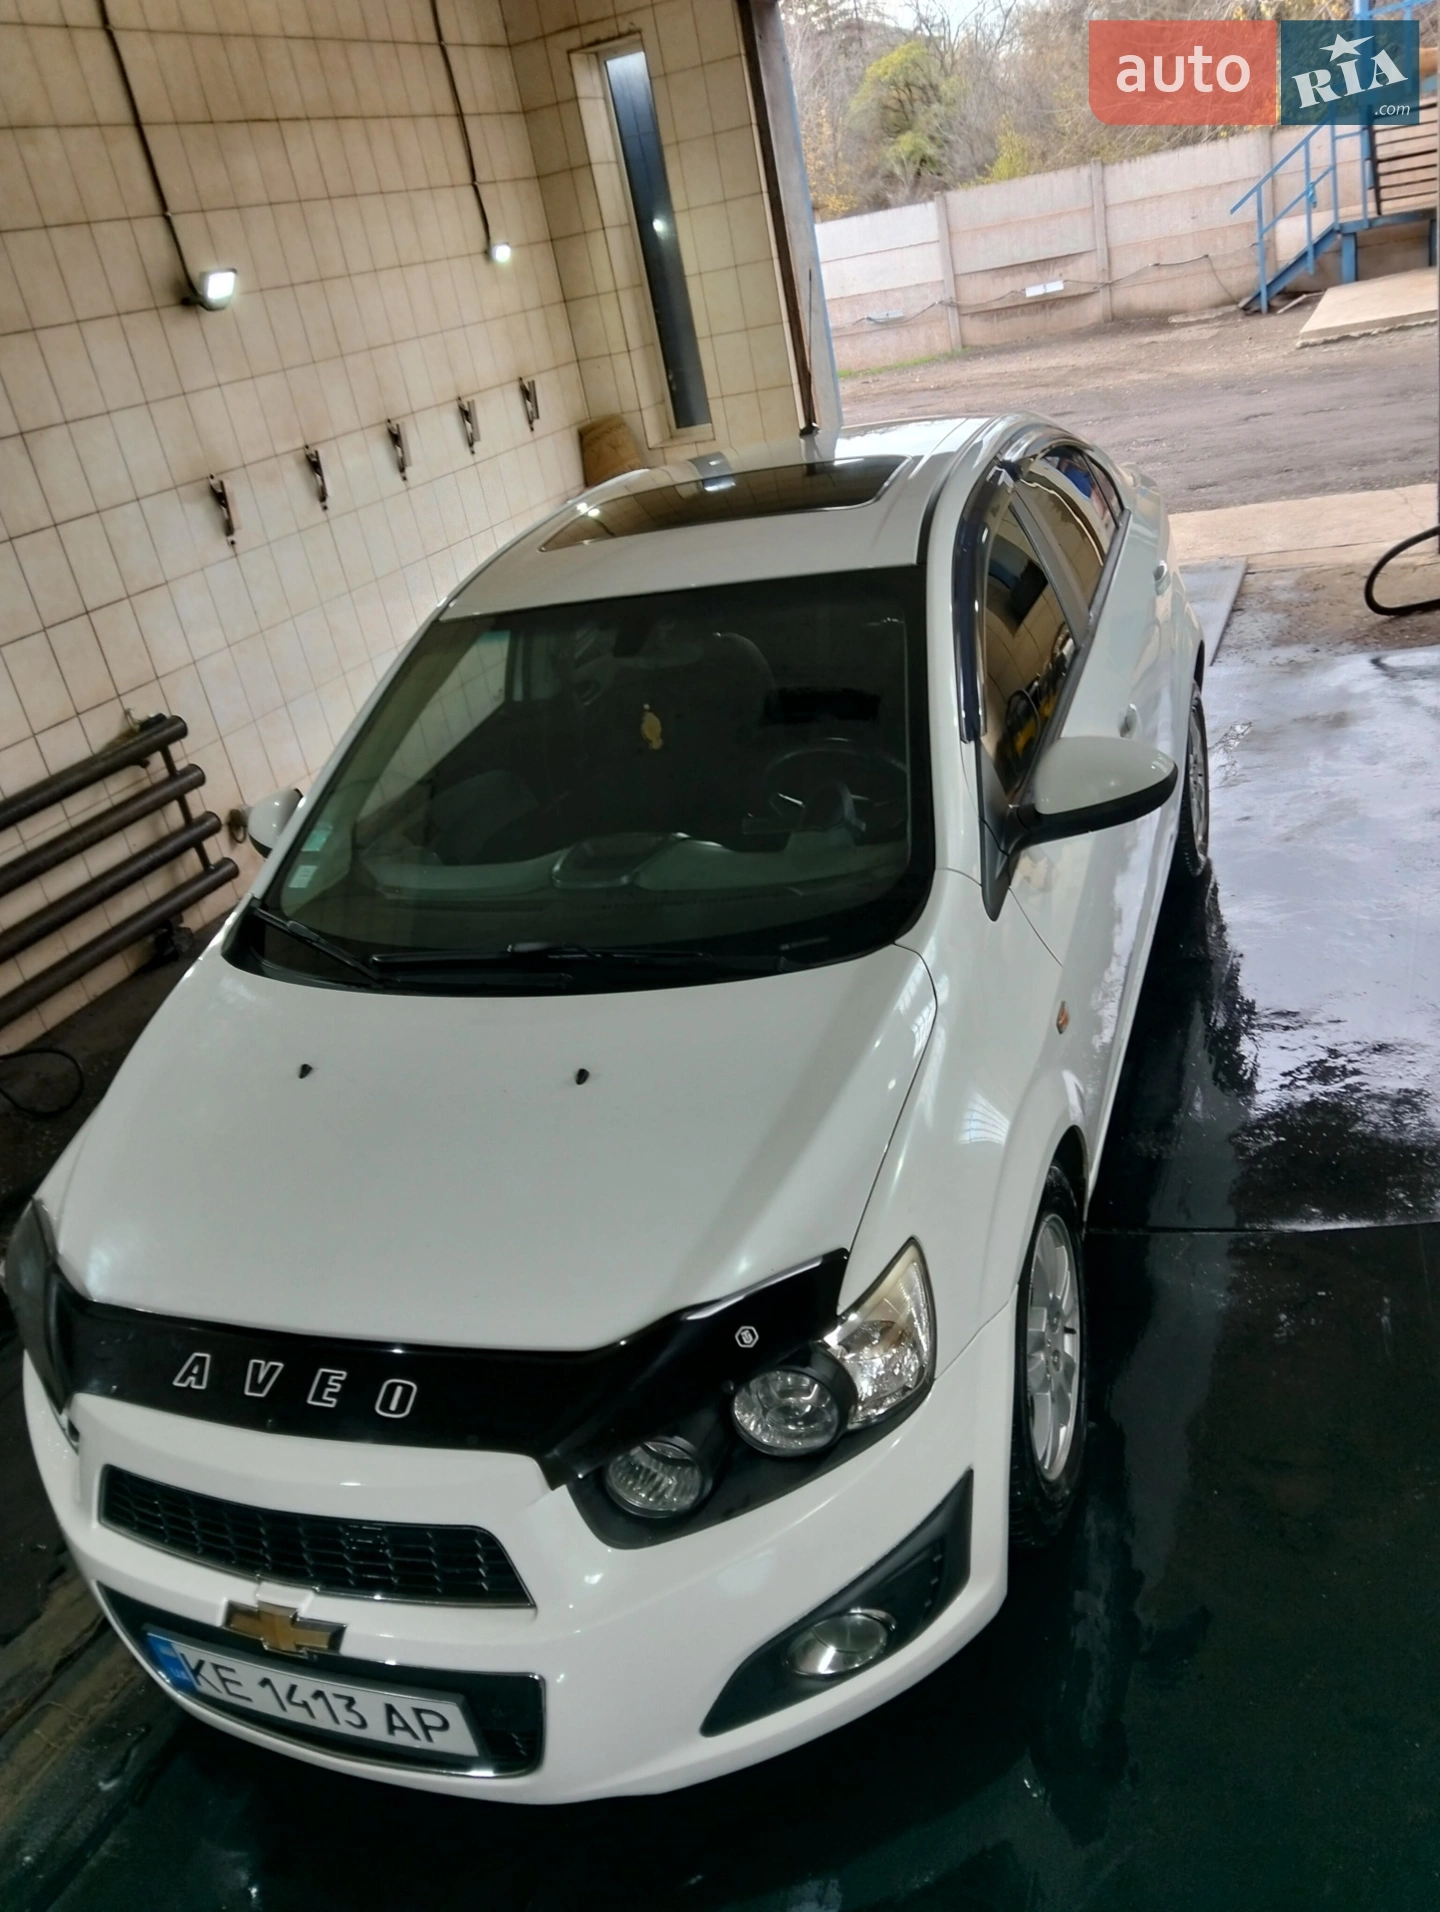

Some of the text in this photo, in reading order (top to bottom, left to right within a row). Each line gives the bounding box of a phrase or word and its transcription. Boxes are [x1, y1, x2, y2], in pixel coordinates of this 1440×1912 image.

[173, 1352, 417, 1418] AVEO
[179, 1652, 451, 1744] KE 1413 AP
